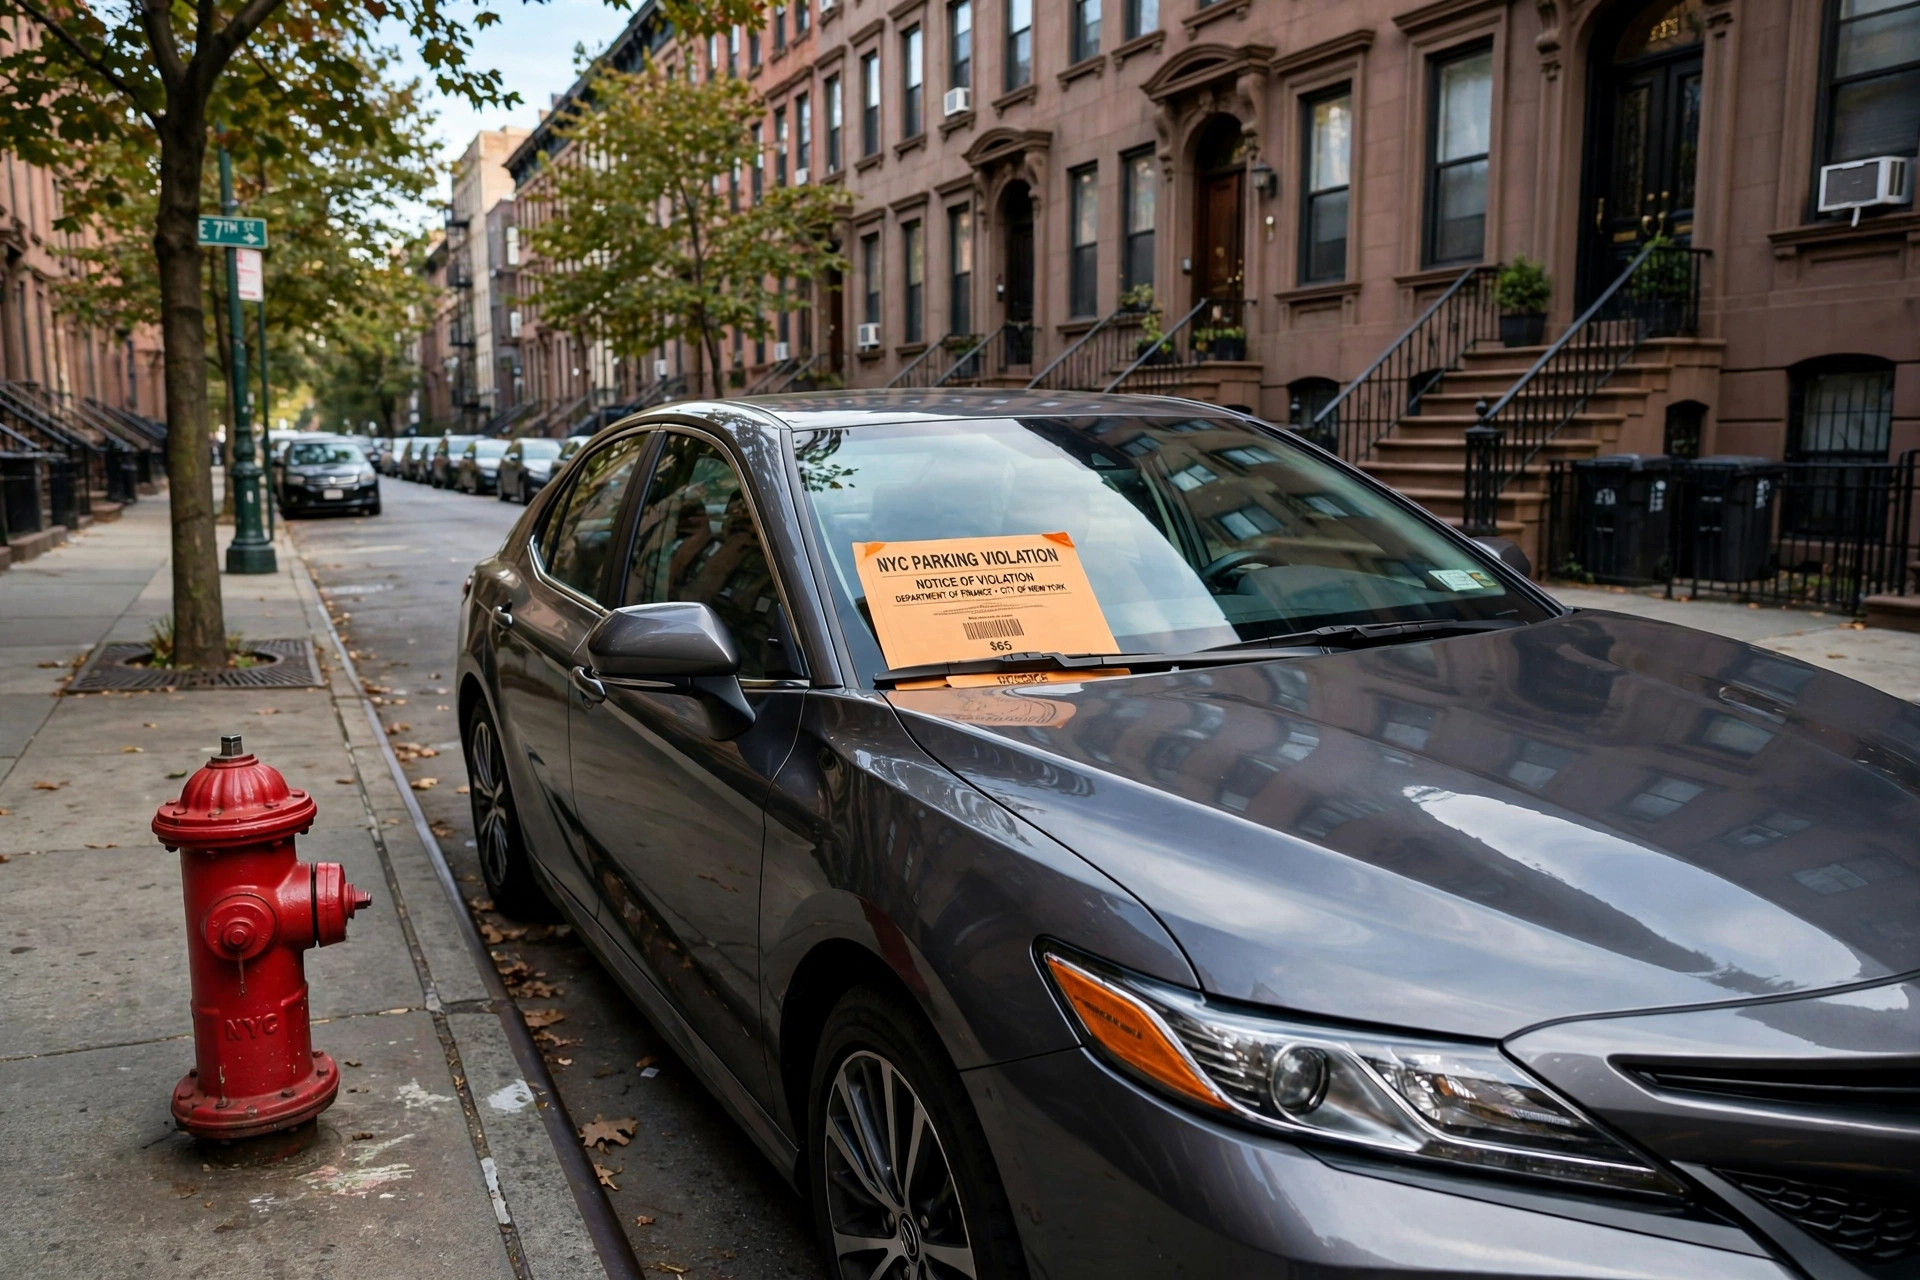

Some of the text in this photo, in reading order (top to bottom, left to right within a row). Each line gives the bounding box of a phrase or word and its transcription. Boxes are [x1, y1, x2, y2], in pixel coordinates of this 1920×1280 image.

[198, 220, 209, 239] E
[212, 220, 238, 240] 7TH
[876, 548, 1059, 572] NYC PARKING VIOLATION
[916, 572, 1035, 589] NOTICE OF VIOLATION
[895, 591, 947, 602] DEPARTMENT
[1000, 586, 1015, 595] CITY
[989, 640, 1013, 651] $65
[225, 1012, 278, 1041] NYC
